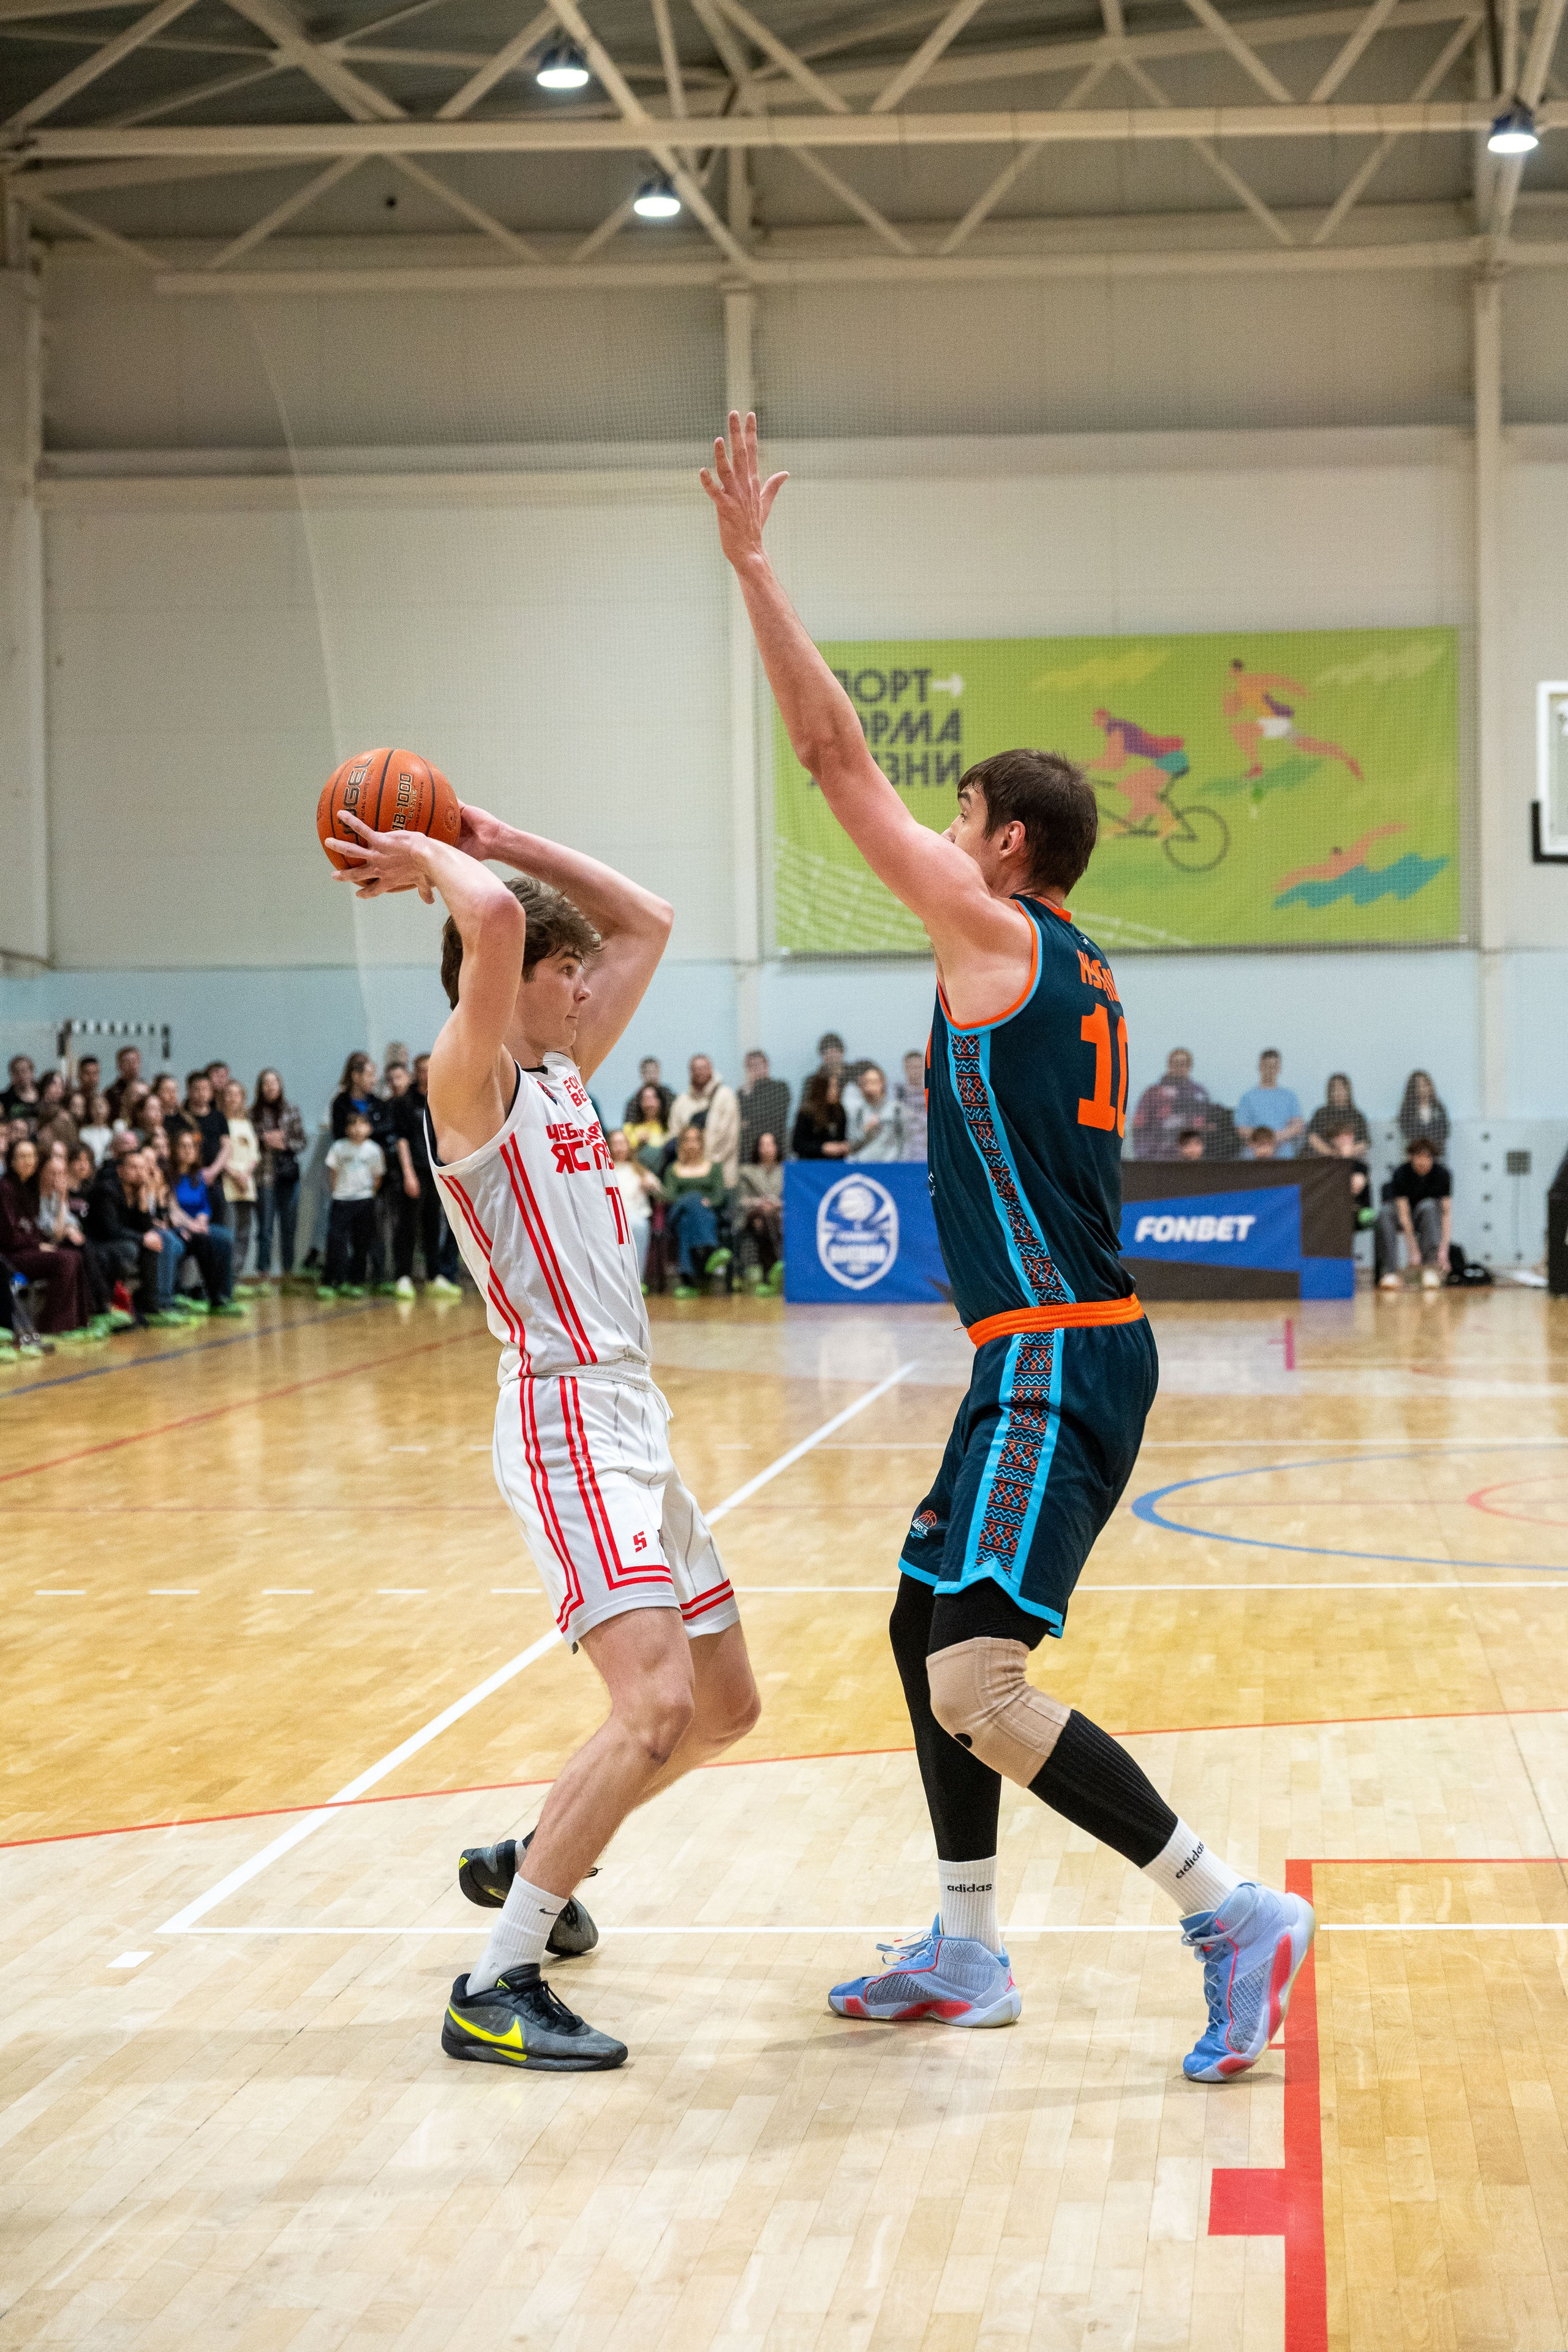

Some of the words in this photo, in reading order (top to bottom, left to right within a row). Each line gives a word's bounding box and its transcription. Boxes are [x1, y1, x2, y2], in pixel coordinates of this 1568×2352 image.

[831, 668, 932, 704] ПОРТ
[858, 709, 962, 745] РМА
[1135, 1215, 1256, 1243] FONBET
[1176, 1841, 1204, 1879] adidas
[947, 1883, 992, 1893] adidas
